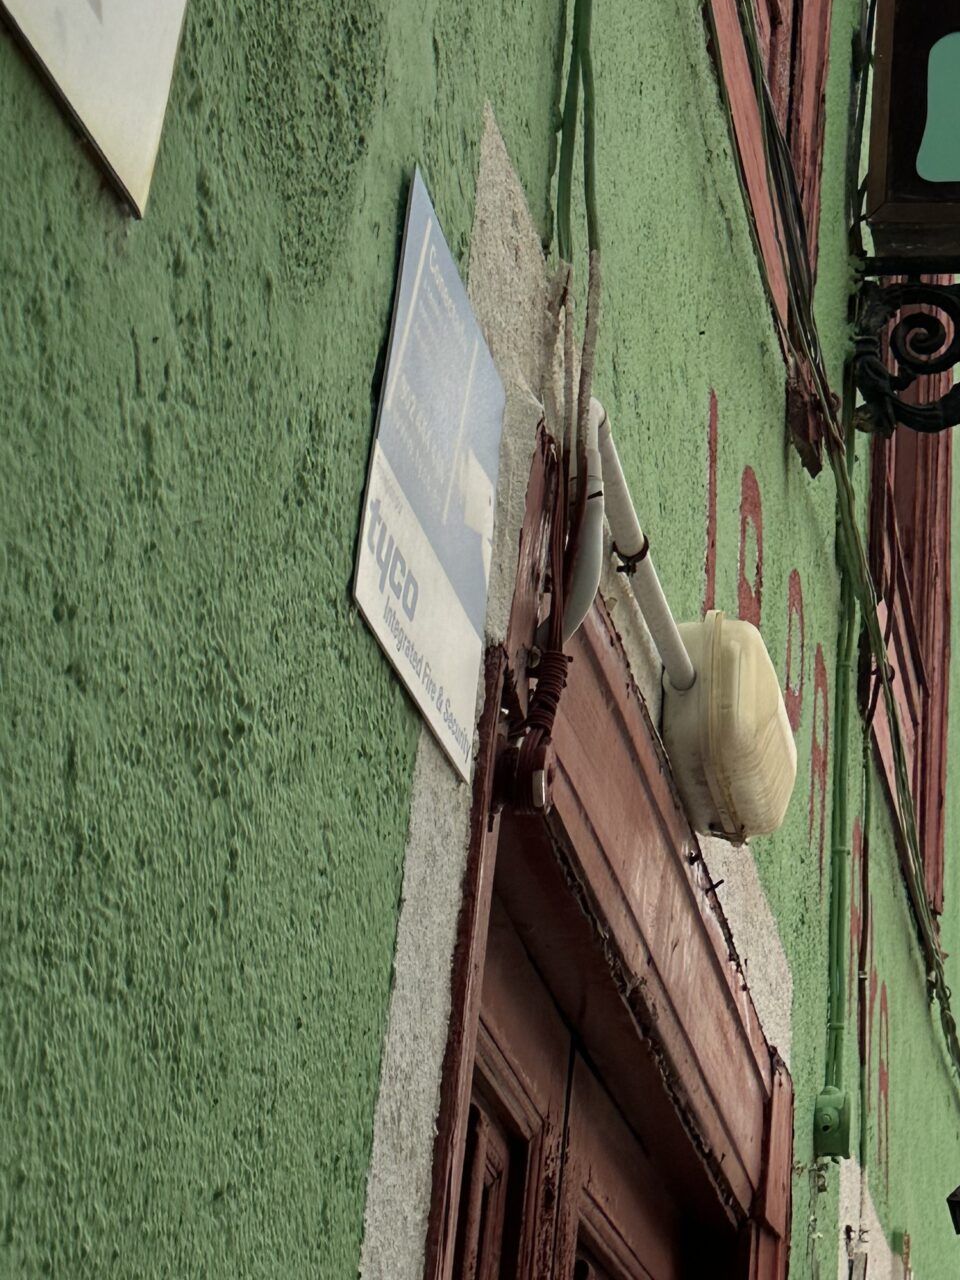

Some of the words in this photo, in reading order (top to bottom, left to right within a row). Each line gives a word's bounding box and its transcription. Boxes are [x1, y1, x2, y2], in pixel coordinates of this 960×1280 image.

[367, 498, 418, 622] tyco
[383, 596, 424, 678] Integrated
[421, 662, 436, 704] Fire
[436, 686, 444, 713] &
[443, 698, 471, 763] Security
